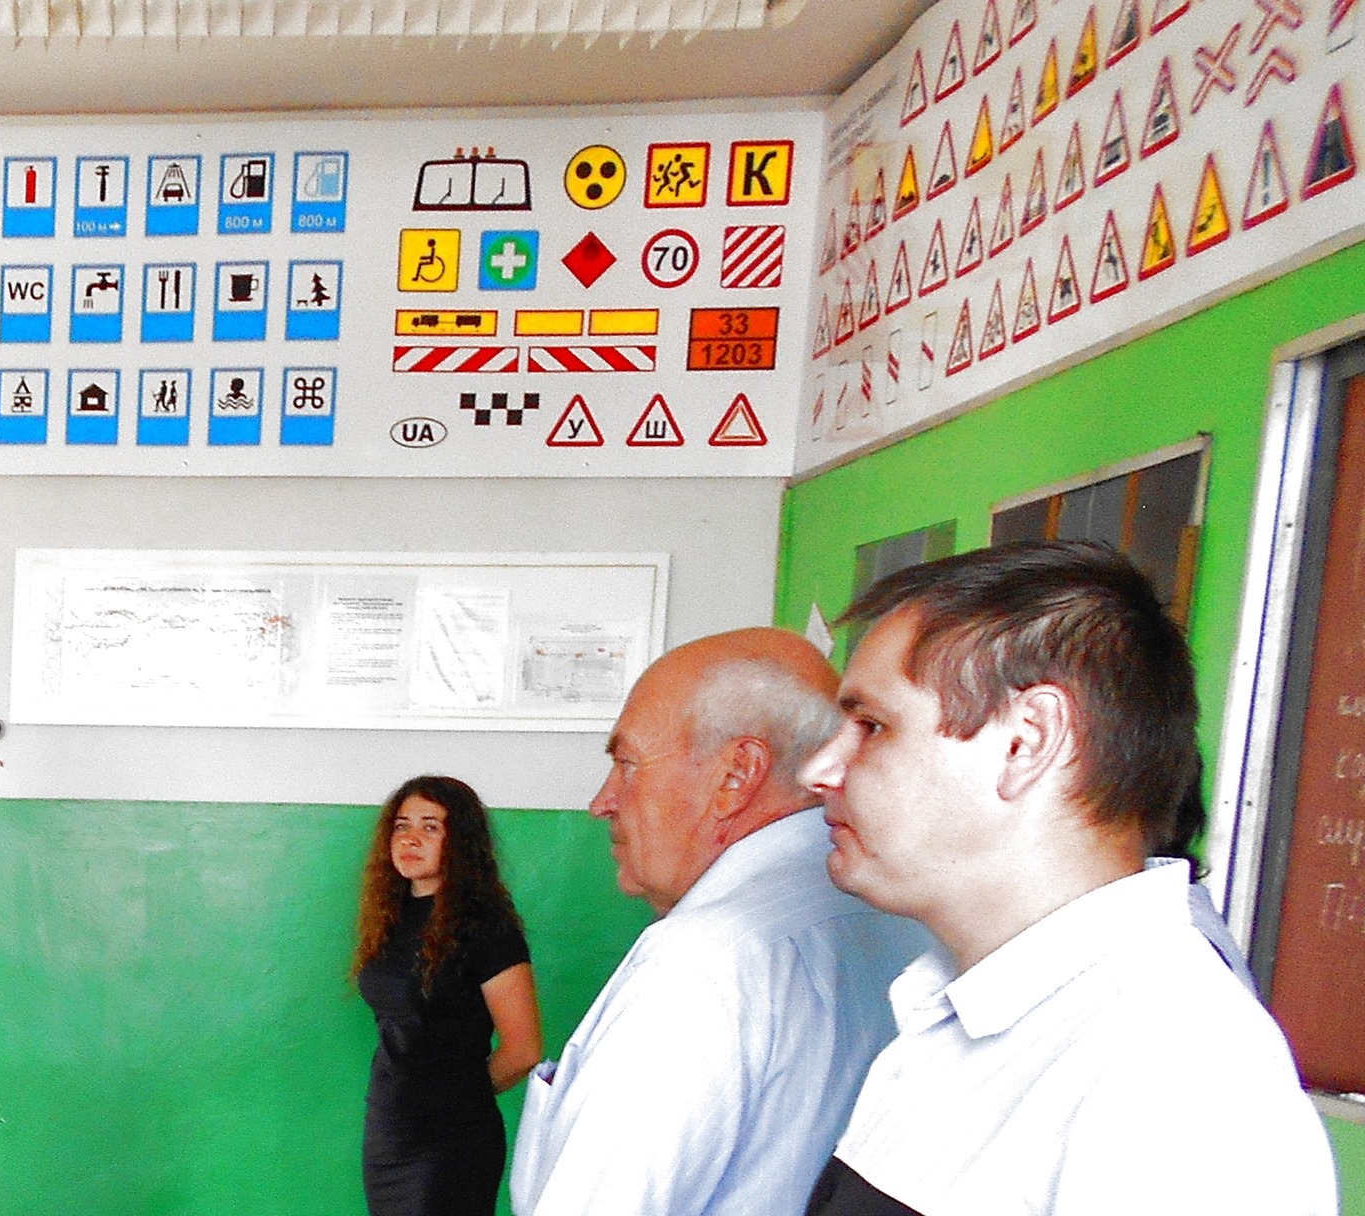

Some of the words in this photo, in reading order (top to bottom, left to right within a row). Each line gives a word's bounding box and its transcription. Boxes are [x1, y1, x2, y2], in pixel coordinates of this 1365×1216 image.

[224, 216, 250, 229] 800
[298, 215, 323, 227] 800
[652, 245, 689, 272] 70
[7, 281, 45, 300] WC
[718, 312, 750, 335] 33
[701, 341, 763, 365] 1203
[401, 424, 435, 442] UA
